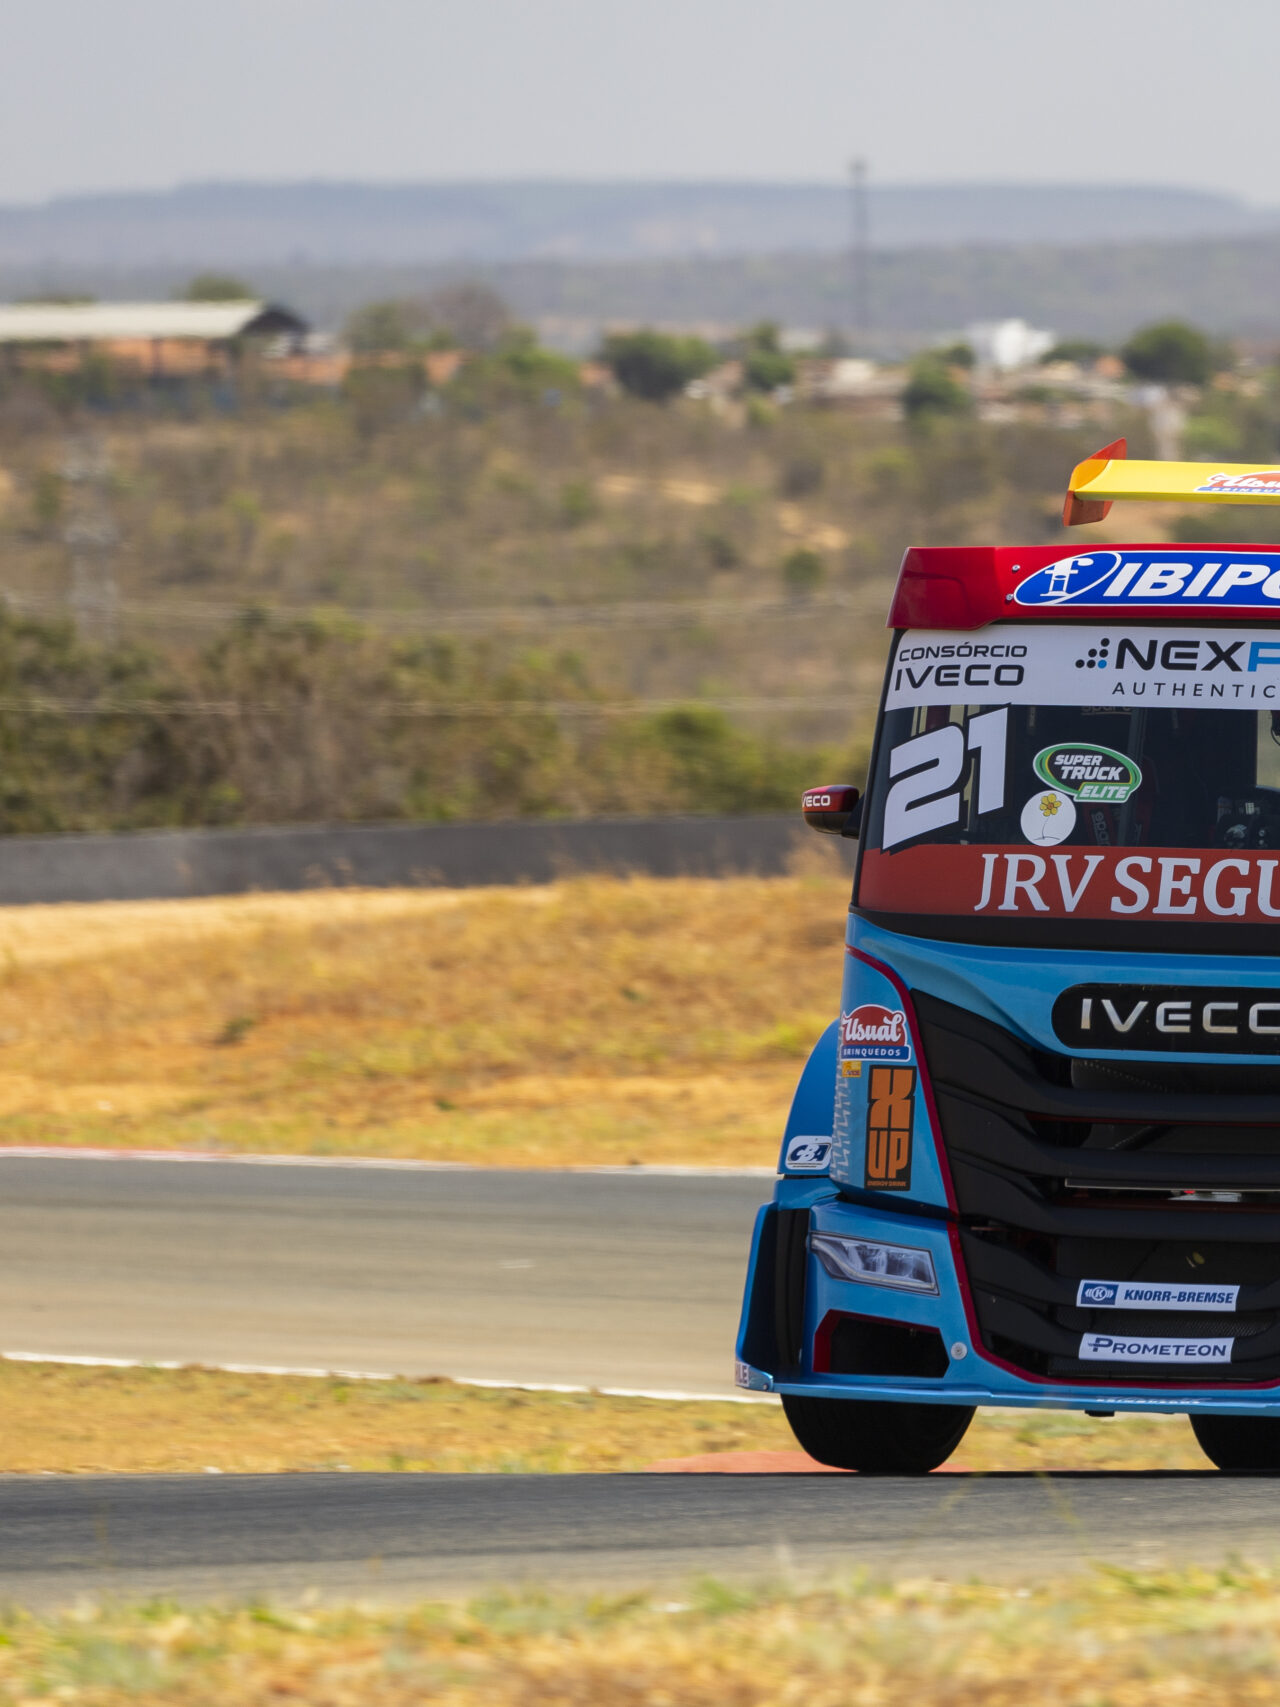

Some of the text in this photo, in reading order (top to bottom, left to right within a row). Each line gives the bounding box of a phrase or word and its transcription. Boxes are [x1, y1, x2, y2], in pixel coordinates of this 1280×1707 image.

[899, 641, 1028, 662] CONSÓRCIO
[894, 664, 1025, 691] IVECO
[1112, 682, 1277, 699] AUTHENTIC
[1054, 755, 1103, 766] SUPER
[882, 707, 1009, 851] 21
[1060, 766, 1124, 781] TRUCK
[1079, 785, 1130, 799] ELITE
[974, 853, 1105, 913] JRV
[842, 1012, 902, 1042] Usual
[843, 1047, 901, 1057] BRINQUEDOS
[789, 1142, 829, 1163] CBA
[868, 1130, 910, 1179] UP
[1124, 1289, 1235, 1304] KNORR-BREMSE
[1089, 1337, 1227, 1357] PROMETEON
